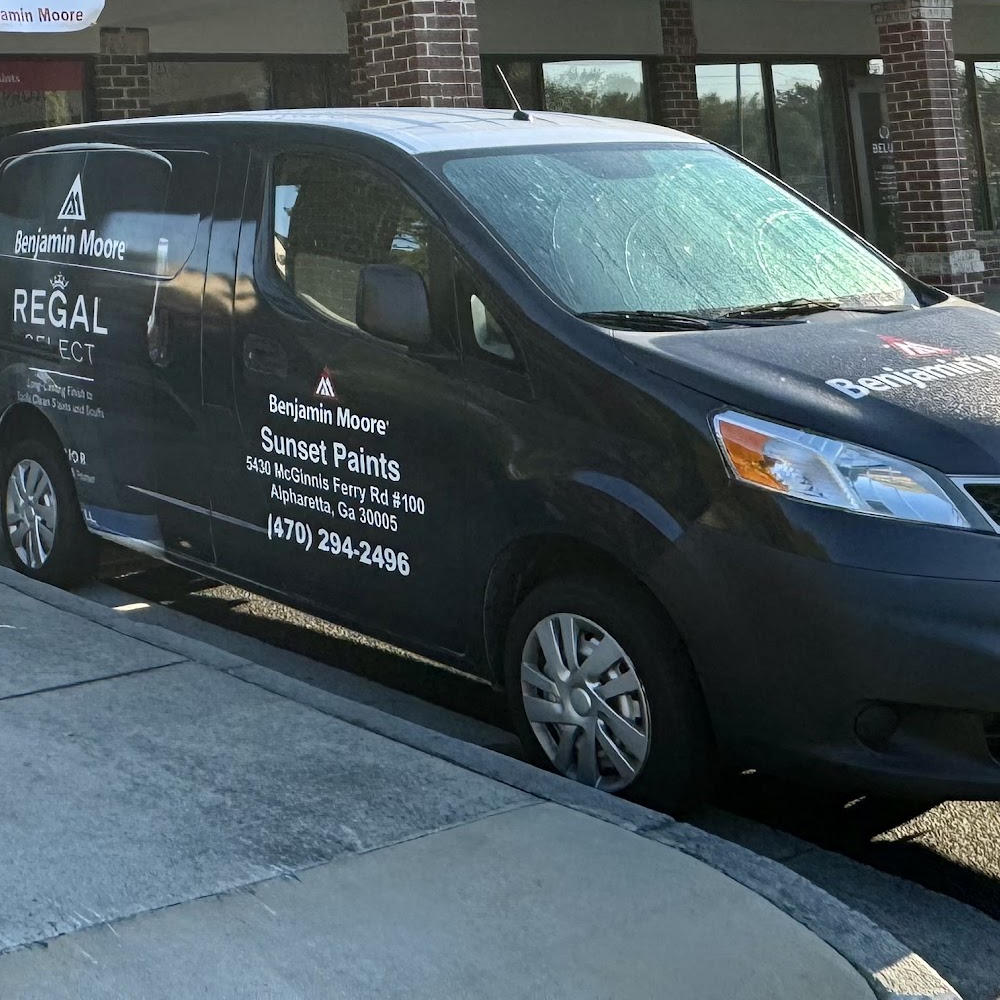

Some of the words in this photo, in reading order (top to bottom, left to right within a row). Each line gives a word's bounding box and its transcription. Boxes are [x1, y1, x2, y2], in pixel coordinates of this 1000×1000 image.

[37, 7, 83, 23] Moore
[872, 143, 894, 154] BELU
[14, 226, 76, 261] Benjamin
[79, 229, 126, 261] Moore
[13, 288, 108, 335] REGAL
[24, 333, 95, 365] ECT
[825, 355, 992, 399] Benjamin
[269, 393, 333, 426] Benjamin
[336, 406, 387, 436] Moore
[260, 426, 328, 466] Sunset
[333, 441, 401, 482] Paints
[246, 455, 272, 475] 5430
[274, 462, 330, 491] McGinnis
[333, 476, 366, 504] Ferry
[370, 485, 389, 506] Rd
[392, 491, 426, 515] #100
[270, 483, 335, 517] Alpharetta,
[337, 500, 356, 521] Ga
[359, 506, 398, 533] 30005
[267, 513, 313, 551] (470)
[317, 528, 411, 577] 294-2496
